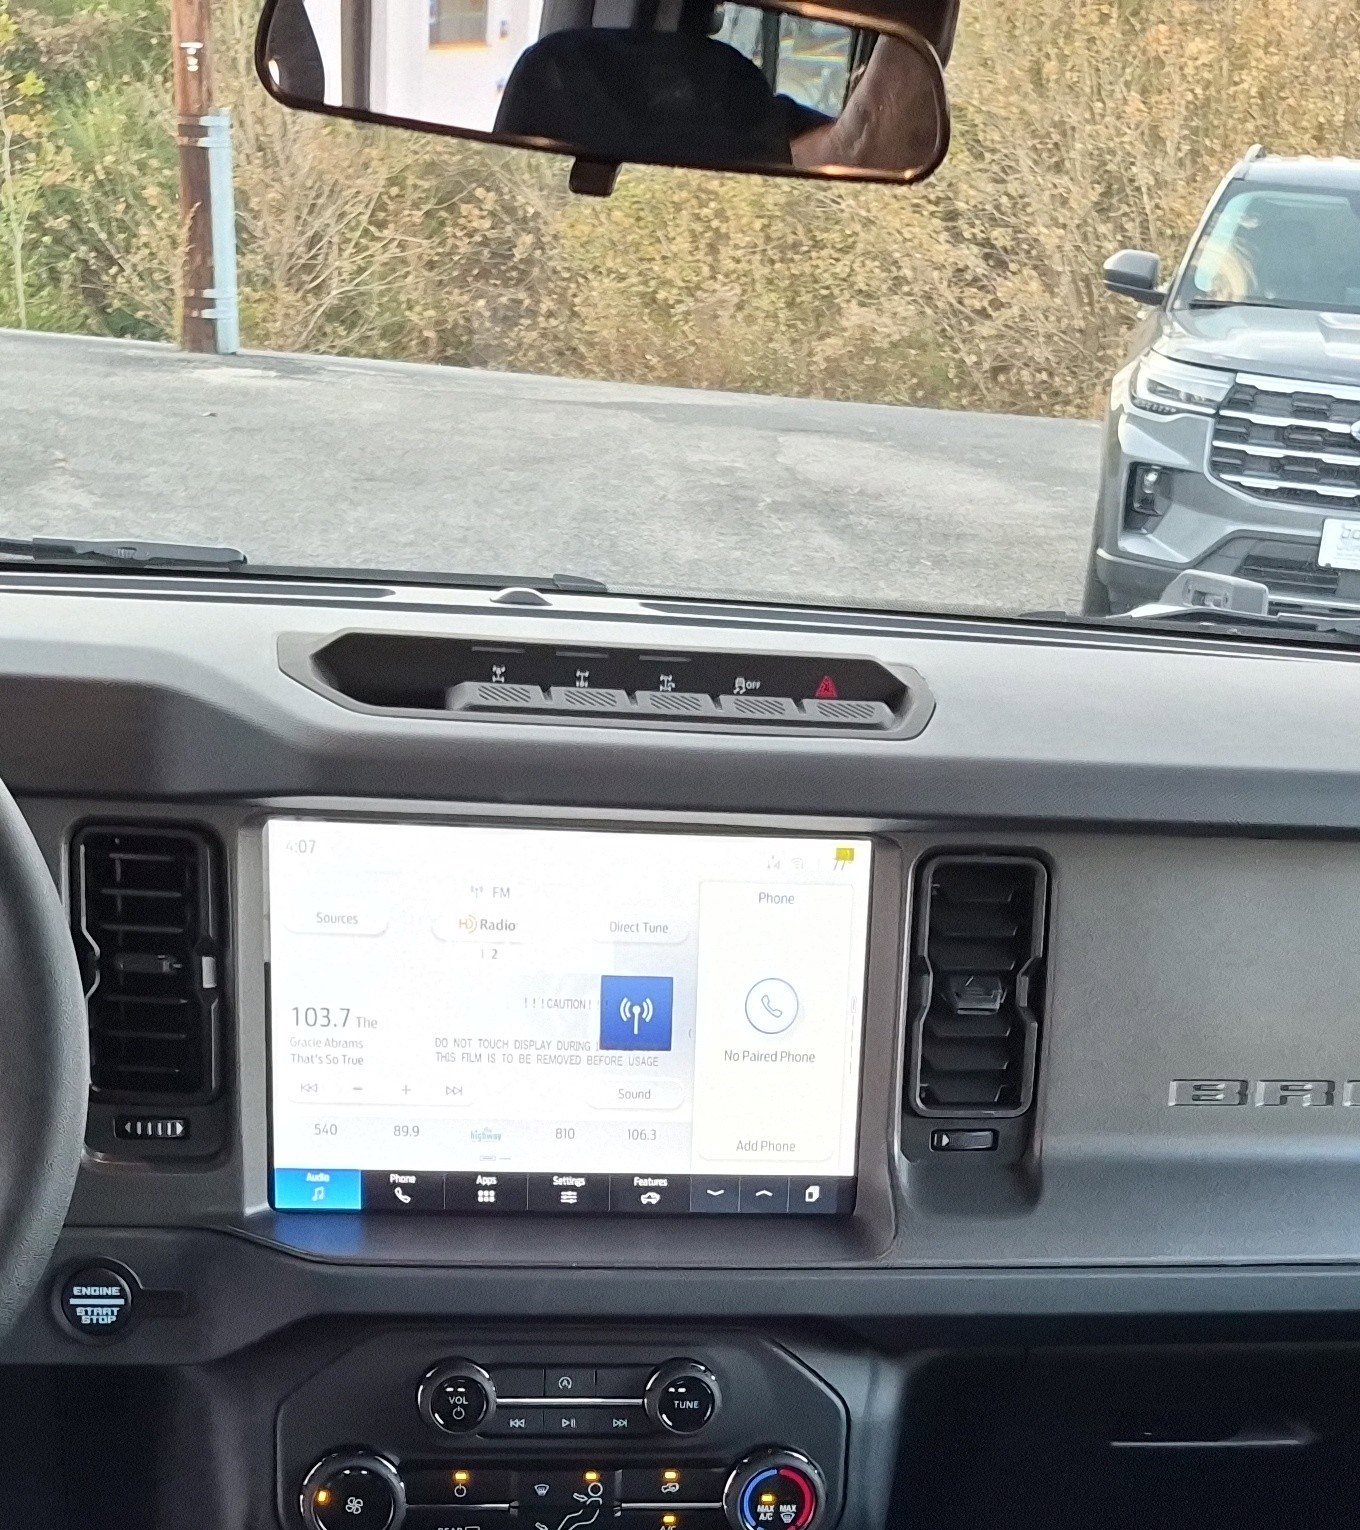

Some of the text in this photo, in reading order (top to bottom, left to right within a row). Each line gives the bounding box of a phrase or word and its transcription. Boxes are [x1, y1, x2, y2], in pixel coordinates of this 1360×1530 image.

[492, 887, 511, 899] FM
[759, 891, 795, 905] Phone
[316, 912, 358, 925] Sources
[480, 919, 517, 932] Radio
[610, 921, 669, 934] Direct Tune
[292, 1006, 378, 1029] 103.7 The
[290, 1037, 364, 1049] Gracie Abrams
[435, 1037, 448, 1048] DO
[454, 1038, 472, 1048] NOT
[478, 1038, 509, 1049] TOUCH
[514, 1039, 552, 1051] DISPLAY
[290, 1053, 364, 1065] That's So True
[436, 1052, 659, 1067] THIS FILM IS TO BE REMOVED BEFORE USAGE
[724, 1050, 816, 1064] No Paired Phone
[618, 1088, 652, 1100] Sound
[314, 1123, 338, 1136] 540
[393, 1125, 420, 1137] 89.9
[555, 1127, 576, 1140] 810
[627, 1128, 658, 1141] 106.3
[736, 1140, 796, 1153] Add Phone
[306, 1172, 330, 1184] Audio
[390, 1173, 417, 1185] Phone
[476, 1174, 498, 1187] Apps
[552, 1175, 586, 1188] Settings
[633, 1176, 668, 1188] Features
[72, 1286, 121, 1296] ENGINE
[76, 1307, 121, 1316] START
[81, 1315, 117, 1325] STOP
[449, 1396, 469, 1405] VOL
[674, 1400, 700, 1410] TUNE
[756, 1504, 775, 1513] MAX
[779, 1504, 797, 1513] MAX
